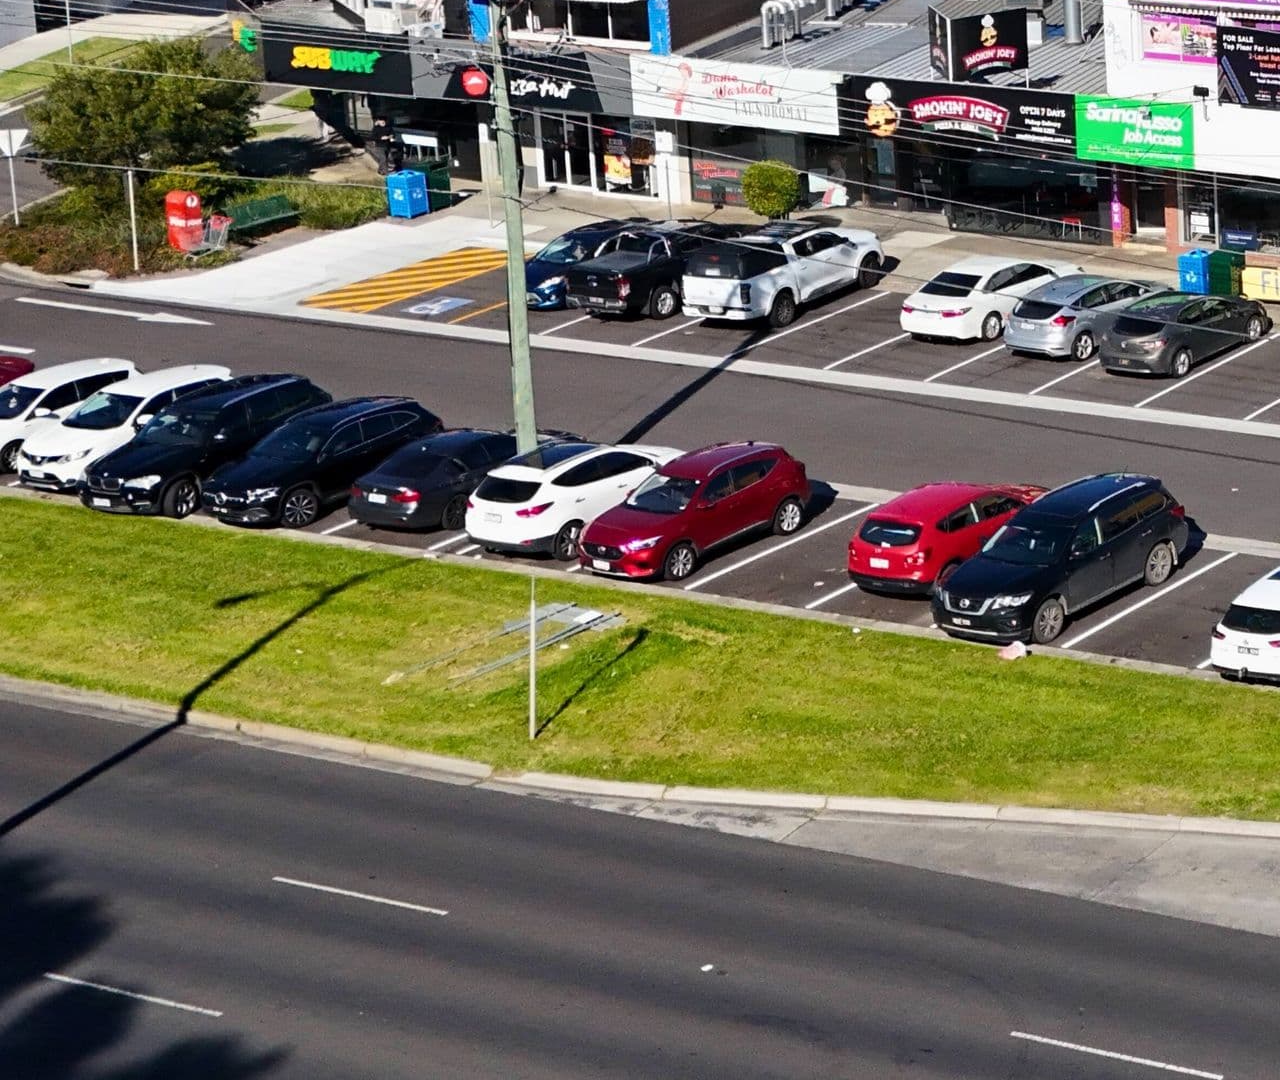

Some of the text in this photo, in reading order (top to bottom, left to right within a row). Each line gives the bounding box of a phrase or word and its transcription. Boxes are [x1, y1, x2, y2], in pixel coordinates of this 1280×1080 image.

[1222, 34, 1254, 43] FOR SALE
[290, 46, 382, 74] SUBWAY
[912, 100, 1004, 126] SMOKIN' JOE'S
[1019, 105, 1040, 116] OPEN
[1046, 107, 1066, 118] DAYS
[1123, 127, 1184, 148] Job Access
